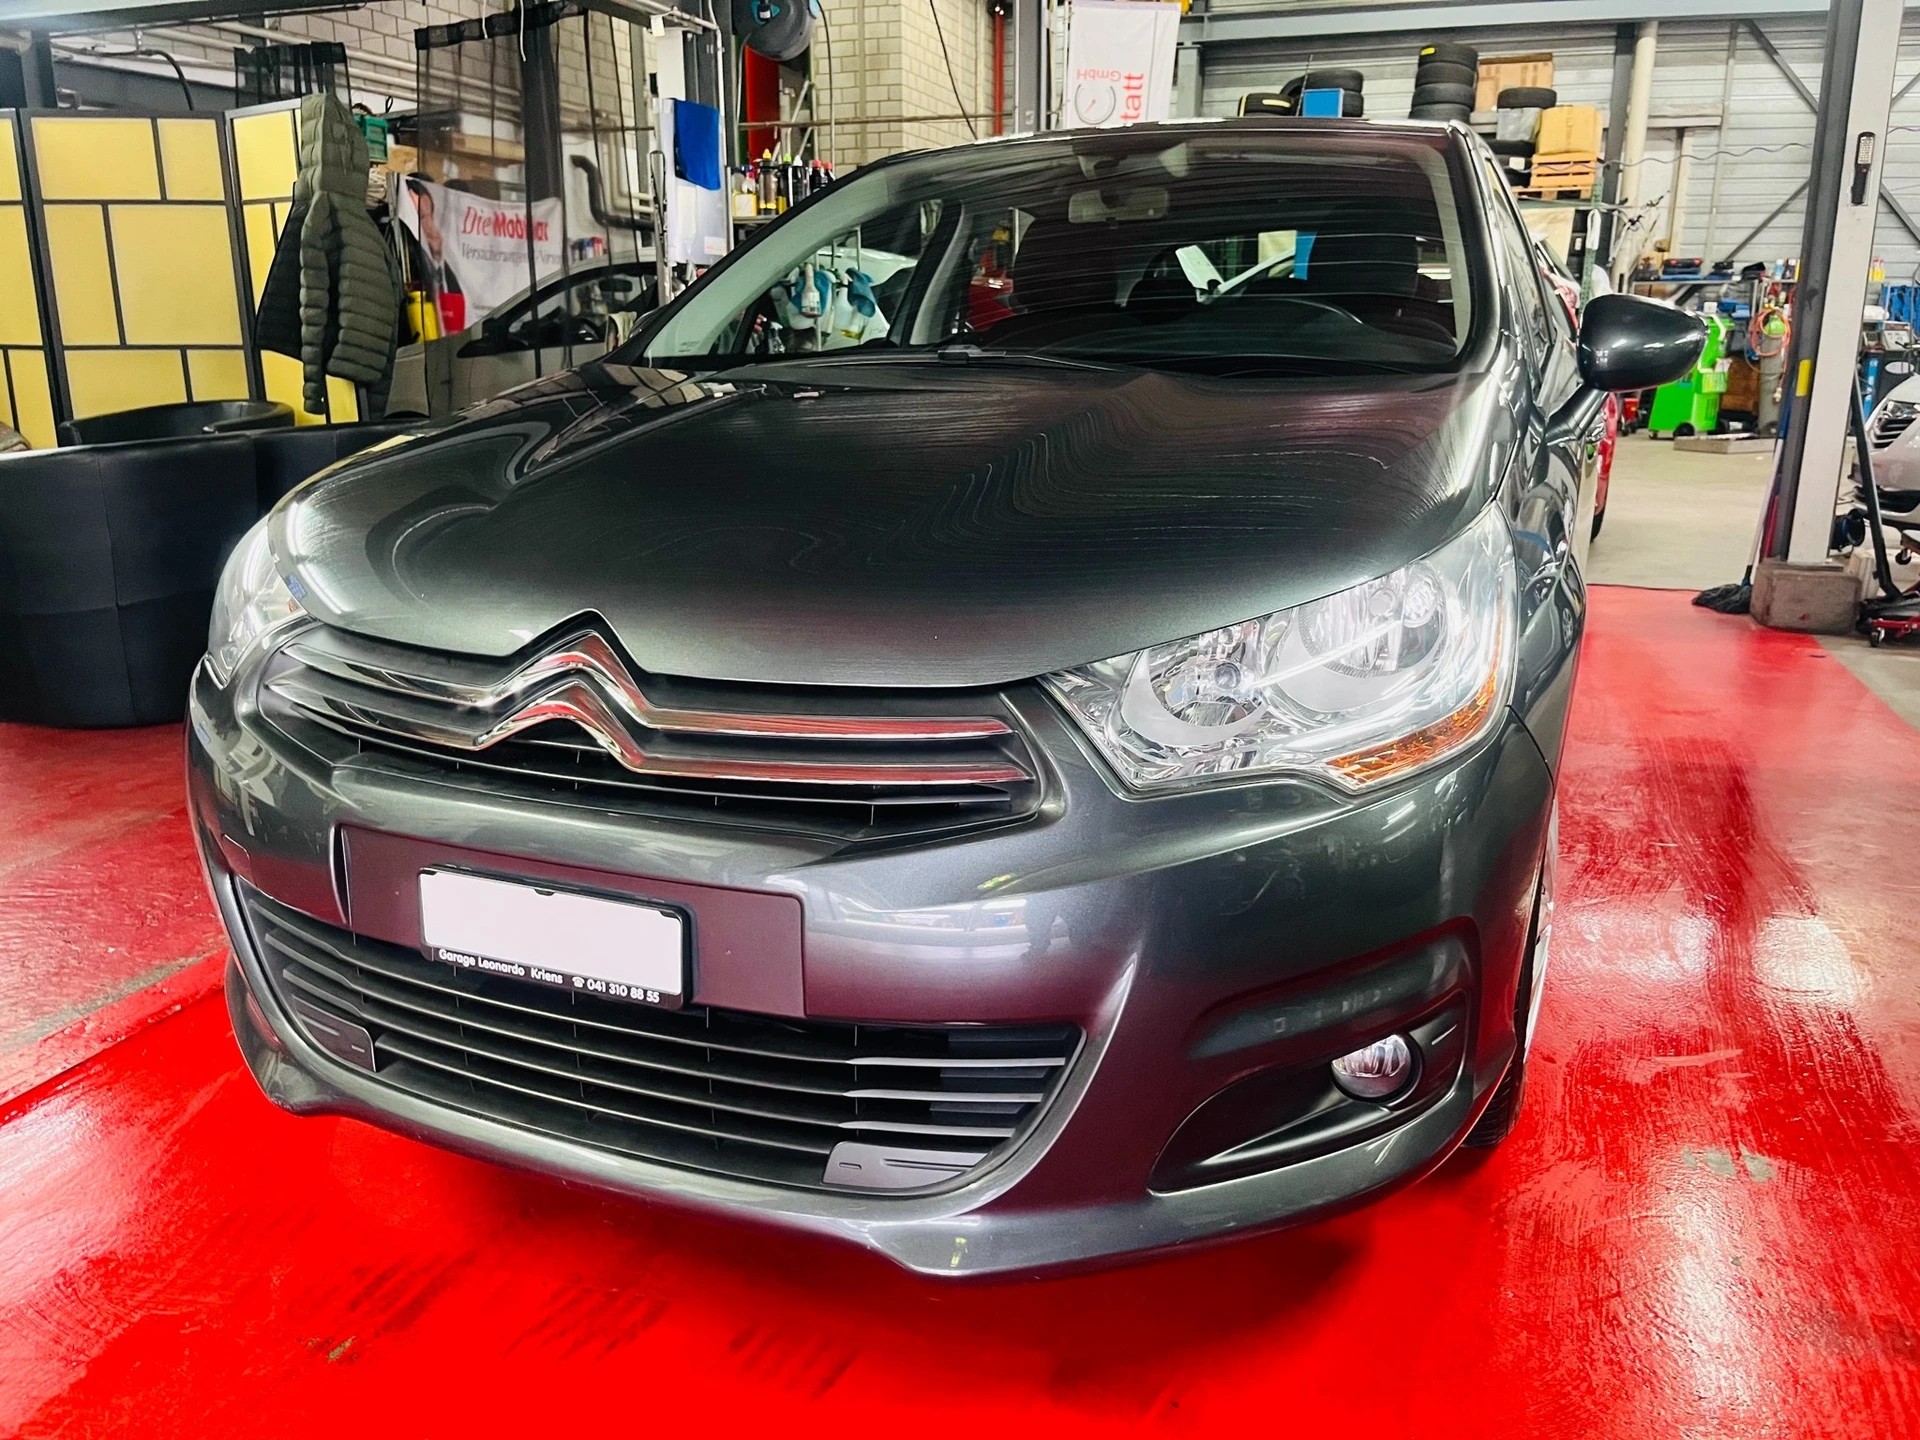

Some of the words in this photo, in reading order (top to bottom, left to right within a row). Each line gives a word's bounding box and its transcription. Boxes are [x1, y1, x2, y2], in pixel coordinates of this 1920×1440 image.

[1076, 67, 1122, 82] GmbH
[461, 206, 492, 236] Die
[439, 948, 476, 967] Garage
[478, 956, 525, 976] Leonardo
[530, 966, 563, 984] Kriens
[587, 979, 606, 992] 041
[608, 983, 628, 997] 310
[630, 987, 644, 1000] 88
[646, 990, 660, 1003] 55
